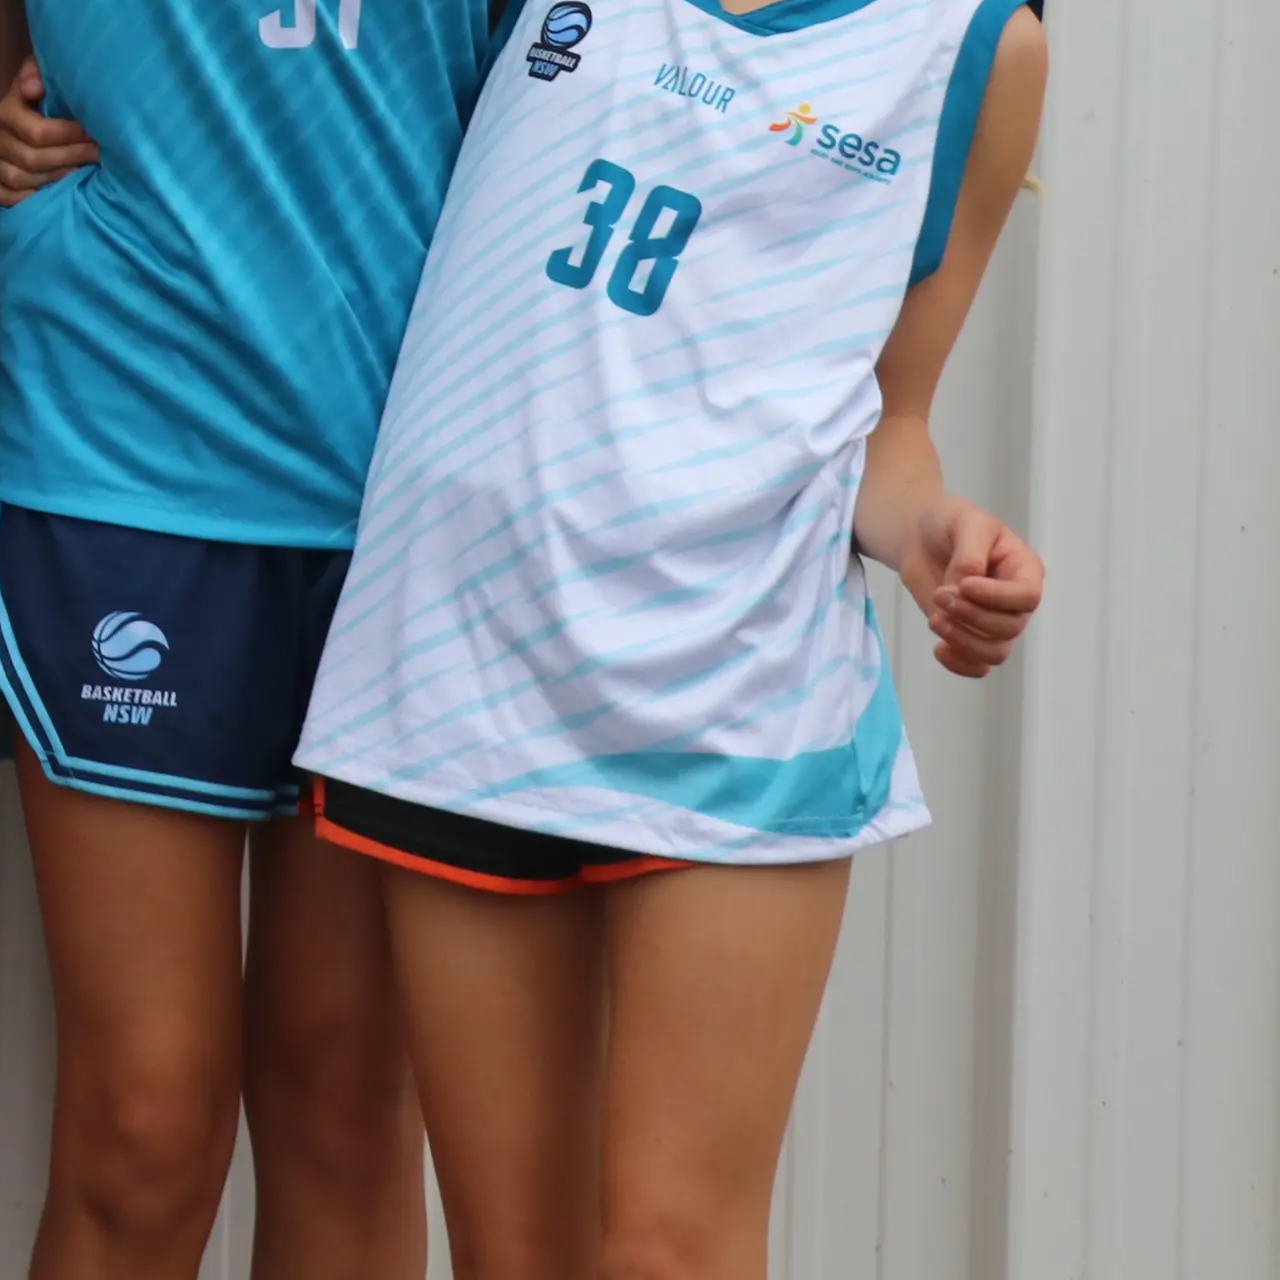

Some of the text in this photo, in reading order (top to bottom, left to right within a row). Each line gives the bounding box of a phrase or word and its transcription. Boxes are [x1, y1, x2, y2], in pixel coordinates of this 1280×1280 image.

[653, 62, 736, 114] VALOUR
[816, 124, 901, 176] sesa
[545, 158, 702, 316] 38
[81, 684, 177, 707] BASKETBALL
[103, 704, 153, 726] NSW
